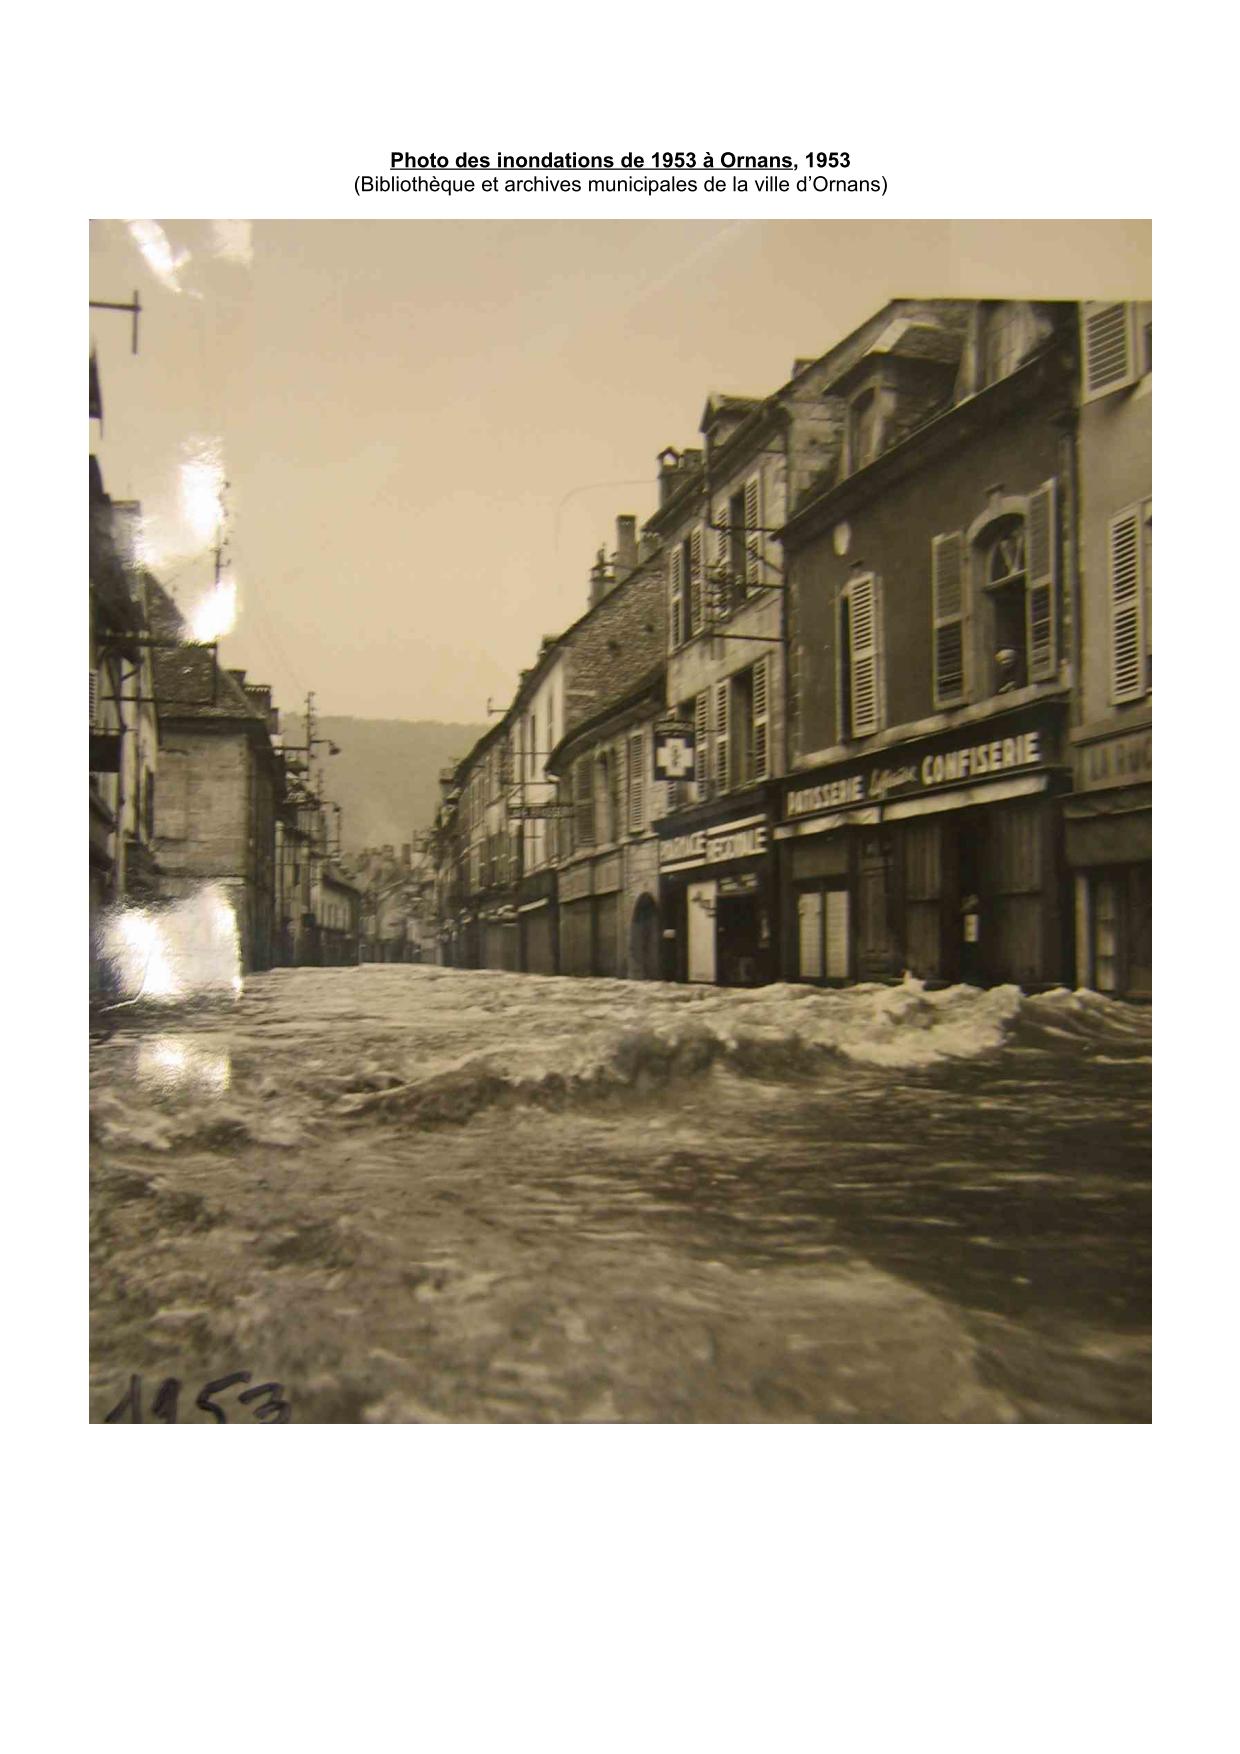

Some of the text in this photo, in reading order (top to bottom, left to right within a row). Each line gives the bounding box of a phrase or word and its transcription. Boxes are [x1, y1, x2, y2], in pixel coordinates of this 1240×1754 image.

[787, 774, 865, 816] PATISSERIE
[921, 731, 1041, 786] CONFISERIE
[104, 1371, 291, 1424] 1953
